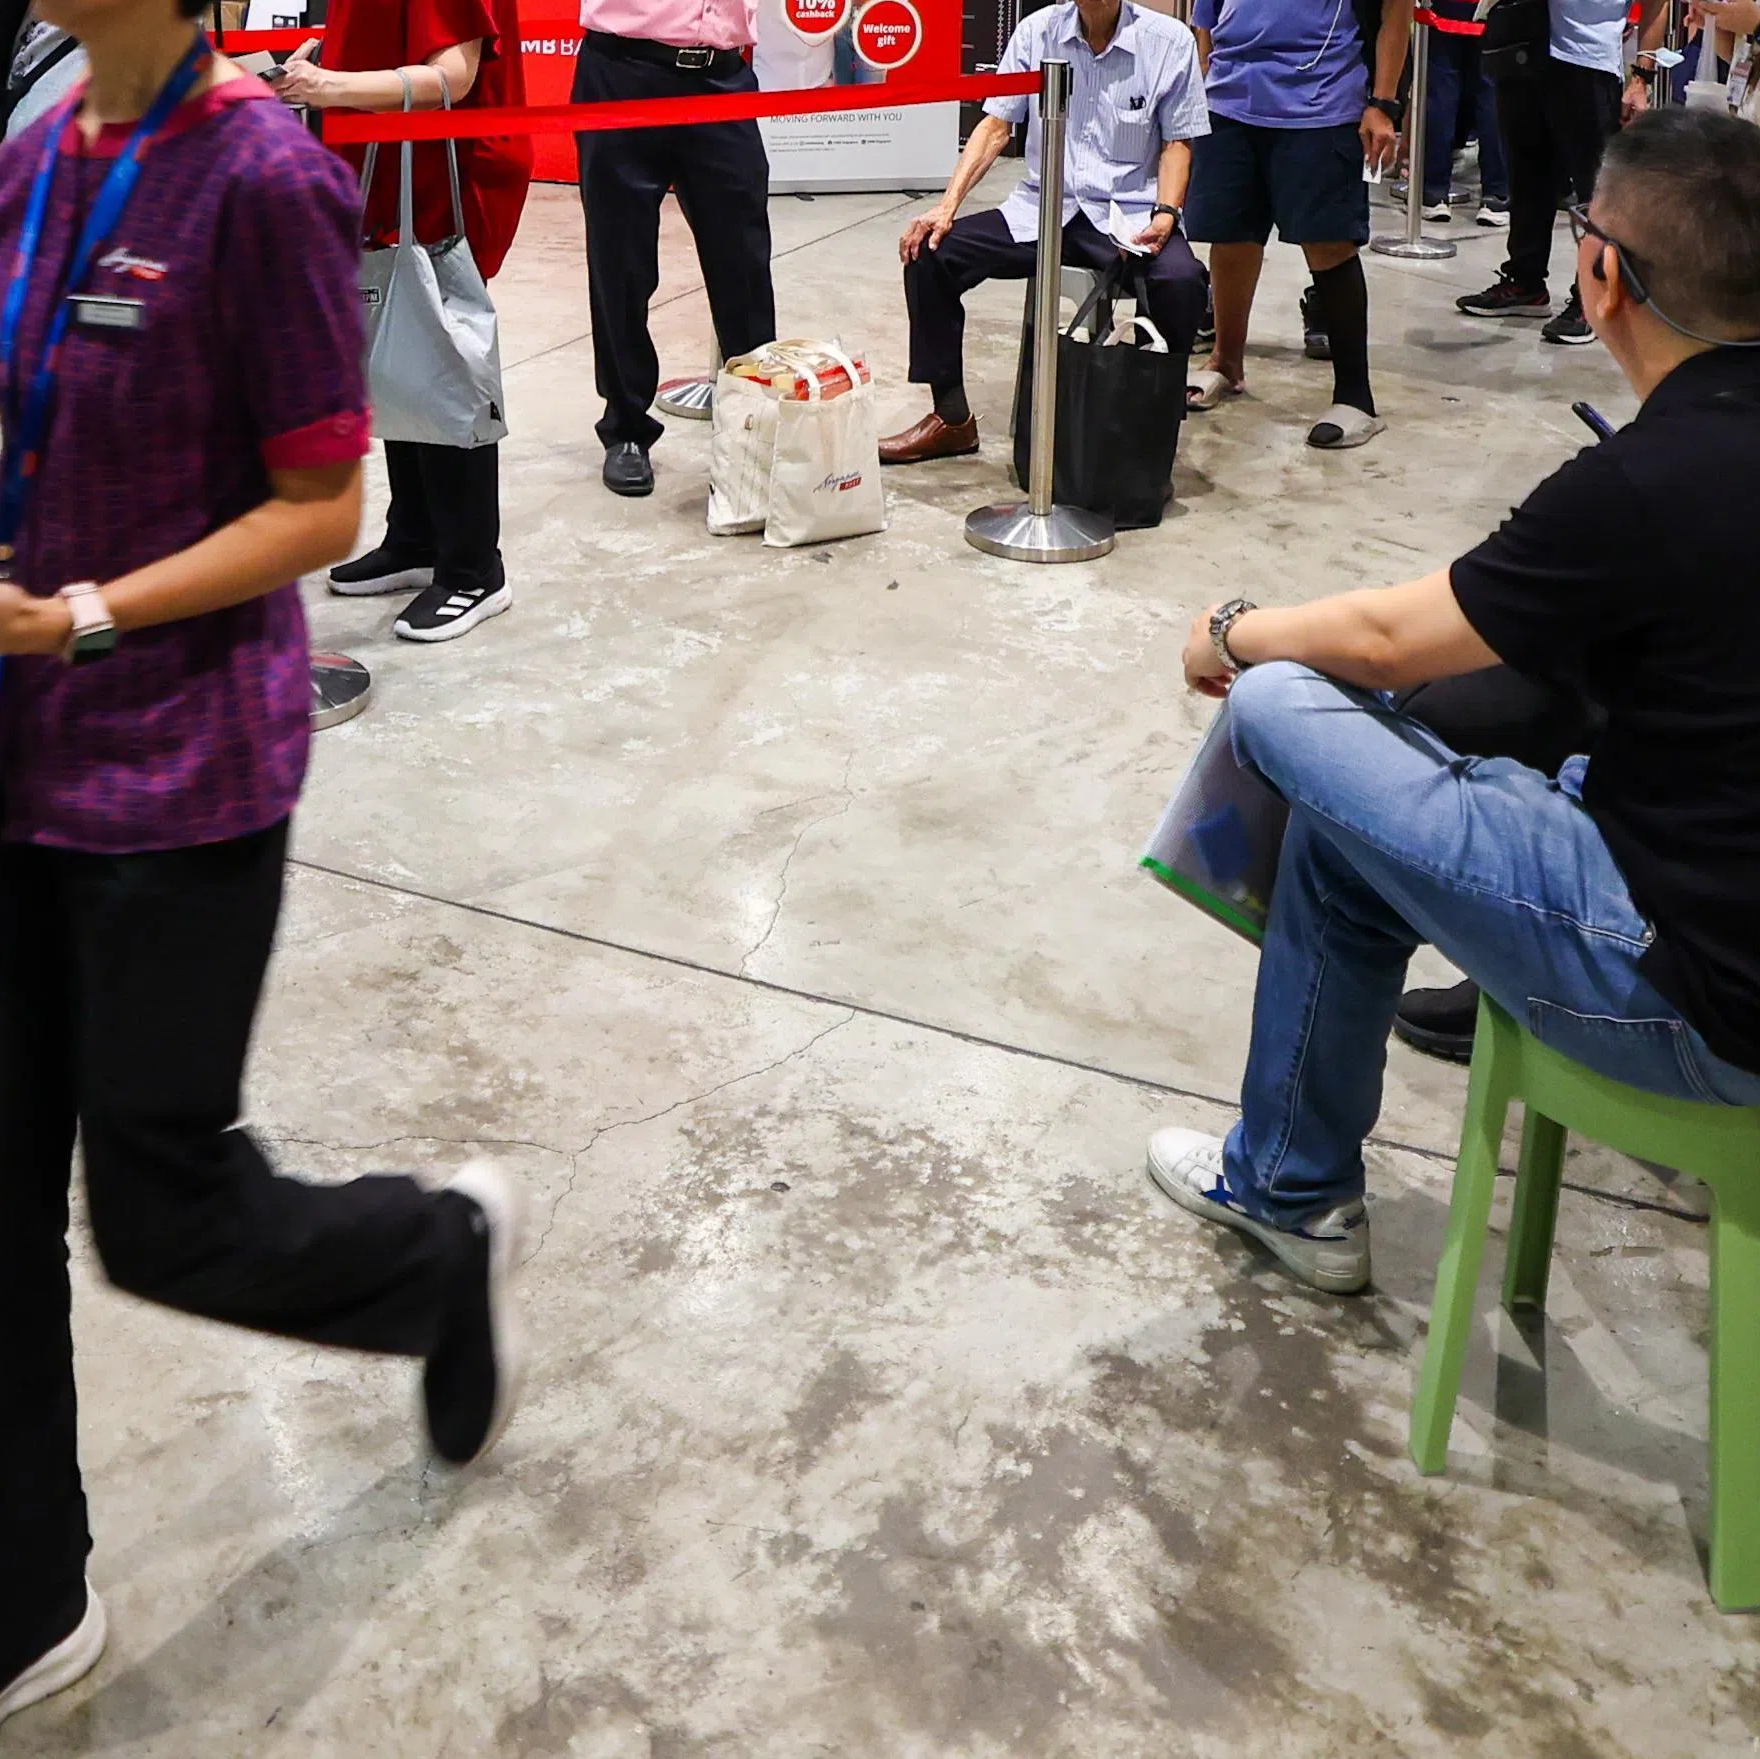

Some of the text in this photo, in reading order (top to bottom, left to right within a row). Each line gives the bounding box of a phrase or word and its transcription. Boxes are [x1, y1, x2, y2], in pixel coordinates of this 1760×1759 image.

[795, 10, 835, 19] cashback
[862, 23, 911, 34] Welcome
[877, 35, 896, 48] gift
[770, 112, 903, 124] MOVING FORWARD WITH YOU
